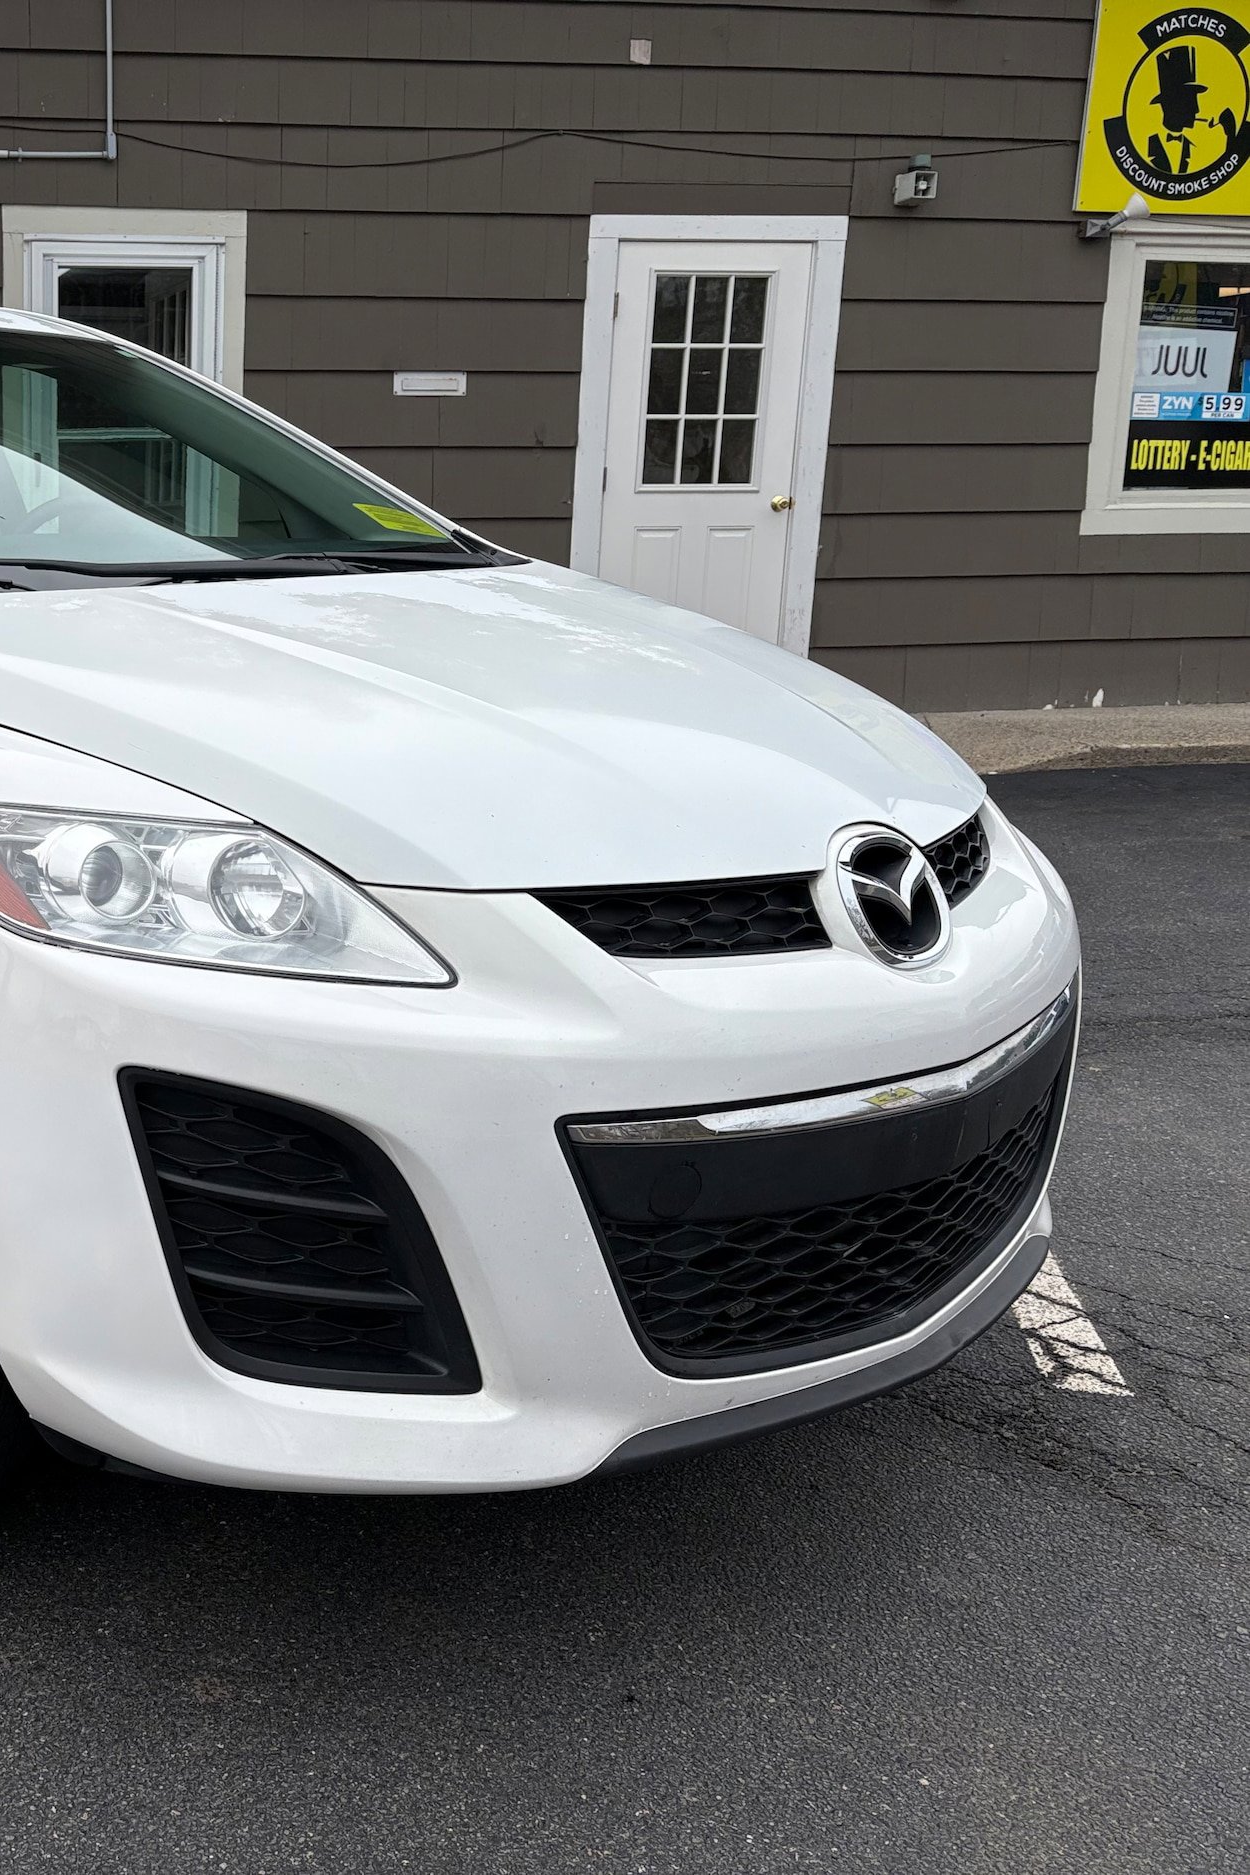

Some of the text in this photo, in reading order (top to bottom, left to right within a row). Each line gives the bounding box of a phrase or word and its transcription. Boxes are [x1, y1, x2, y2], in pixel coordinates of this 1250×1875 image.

[1156, 14, 1227, 38] MATCHES
[1115, 146, 1239, 195] DISCOUNT SMOKE SHOP
[1151, 344, 1207, 378] JUUL
[1162, 396, 1193, 410] ZYN
[1130, 439, 1191, 470] LOTTERY
